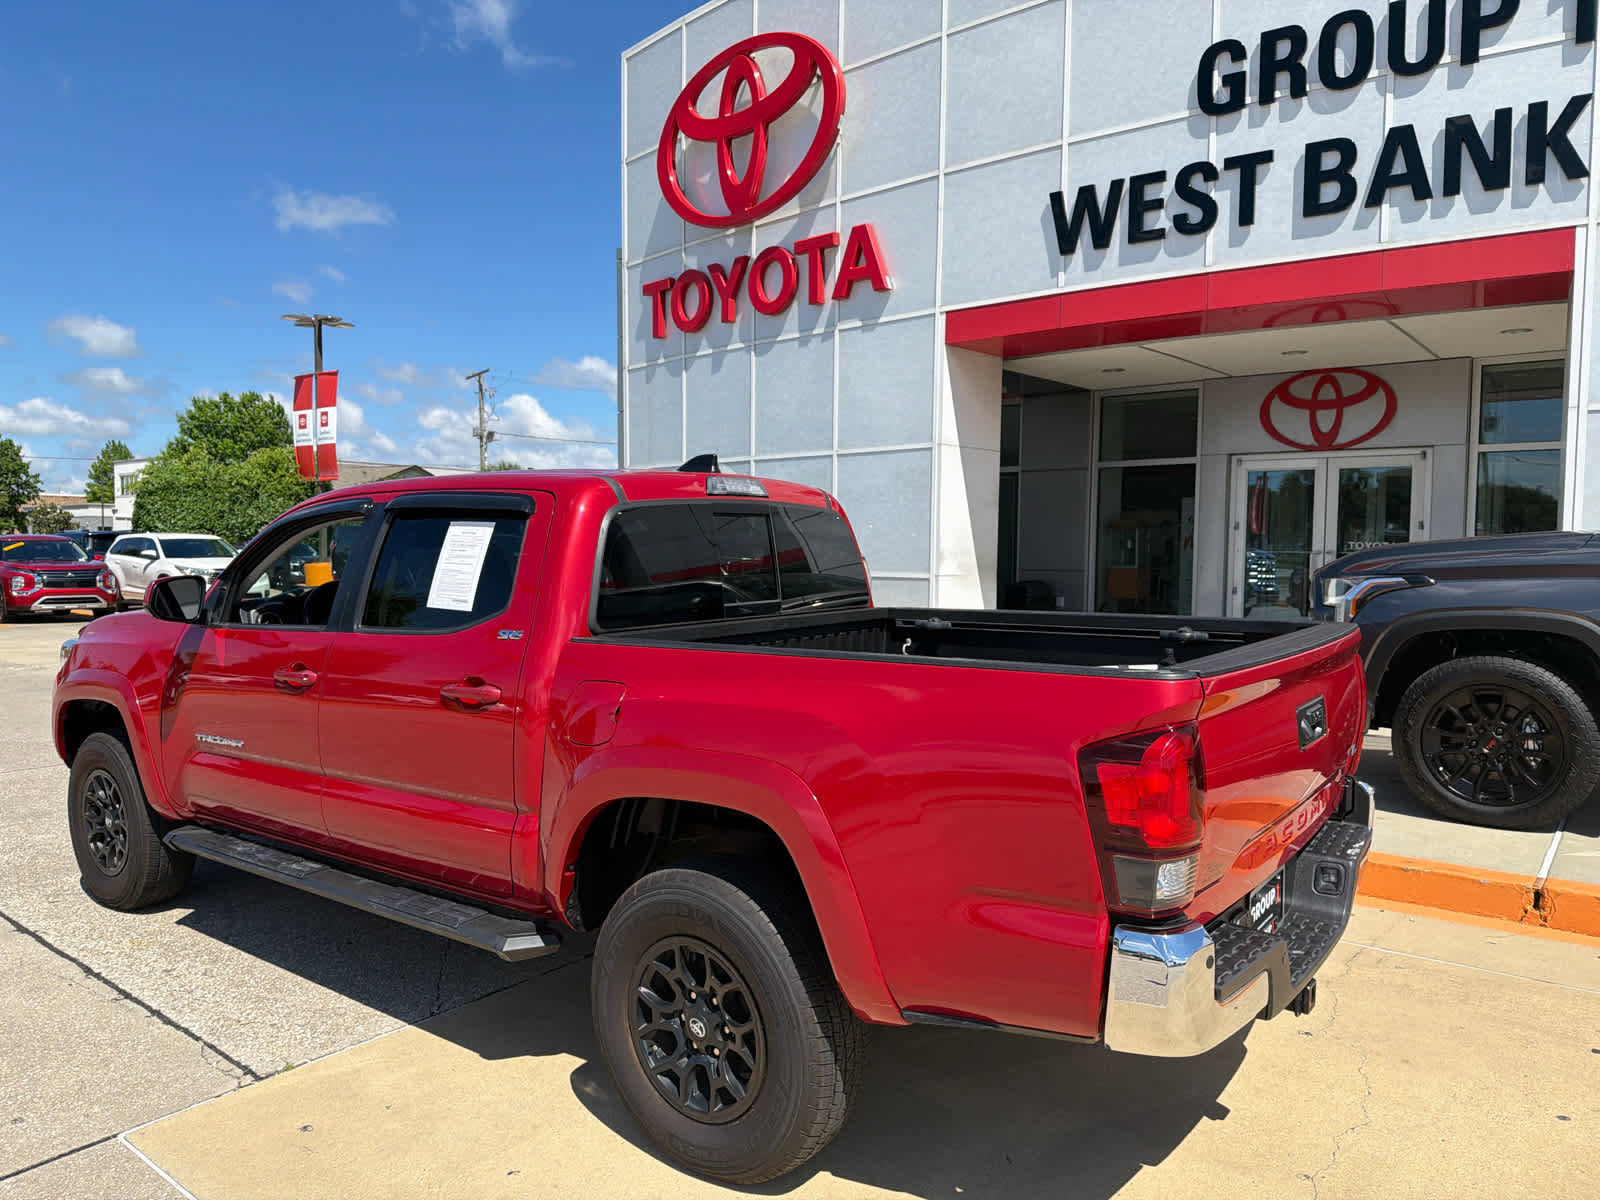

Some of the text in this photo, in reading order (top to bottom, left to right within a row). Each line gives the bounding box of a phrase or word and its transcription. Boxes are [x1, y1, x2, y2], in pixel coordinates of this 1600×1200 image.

[1199, 0, 1520, 116] GROUP
[1049, 93, 1593, 256] WEST BANK
[642, 223, 894, 339] TOYOTA
[1348, 541, 1389, 550] TOYO
